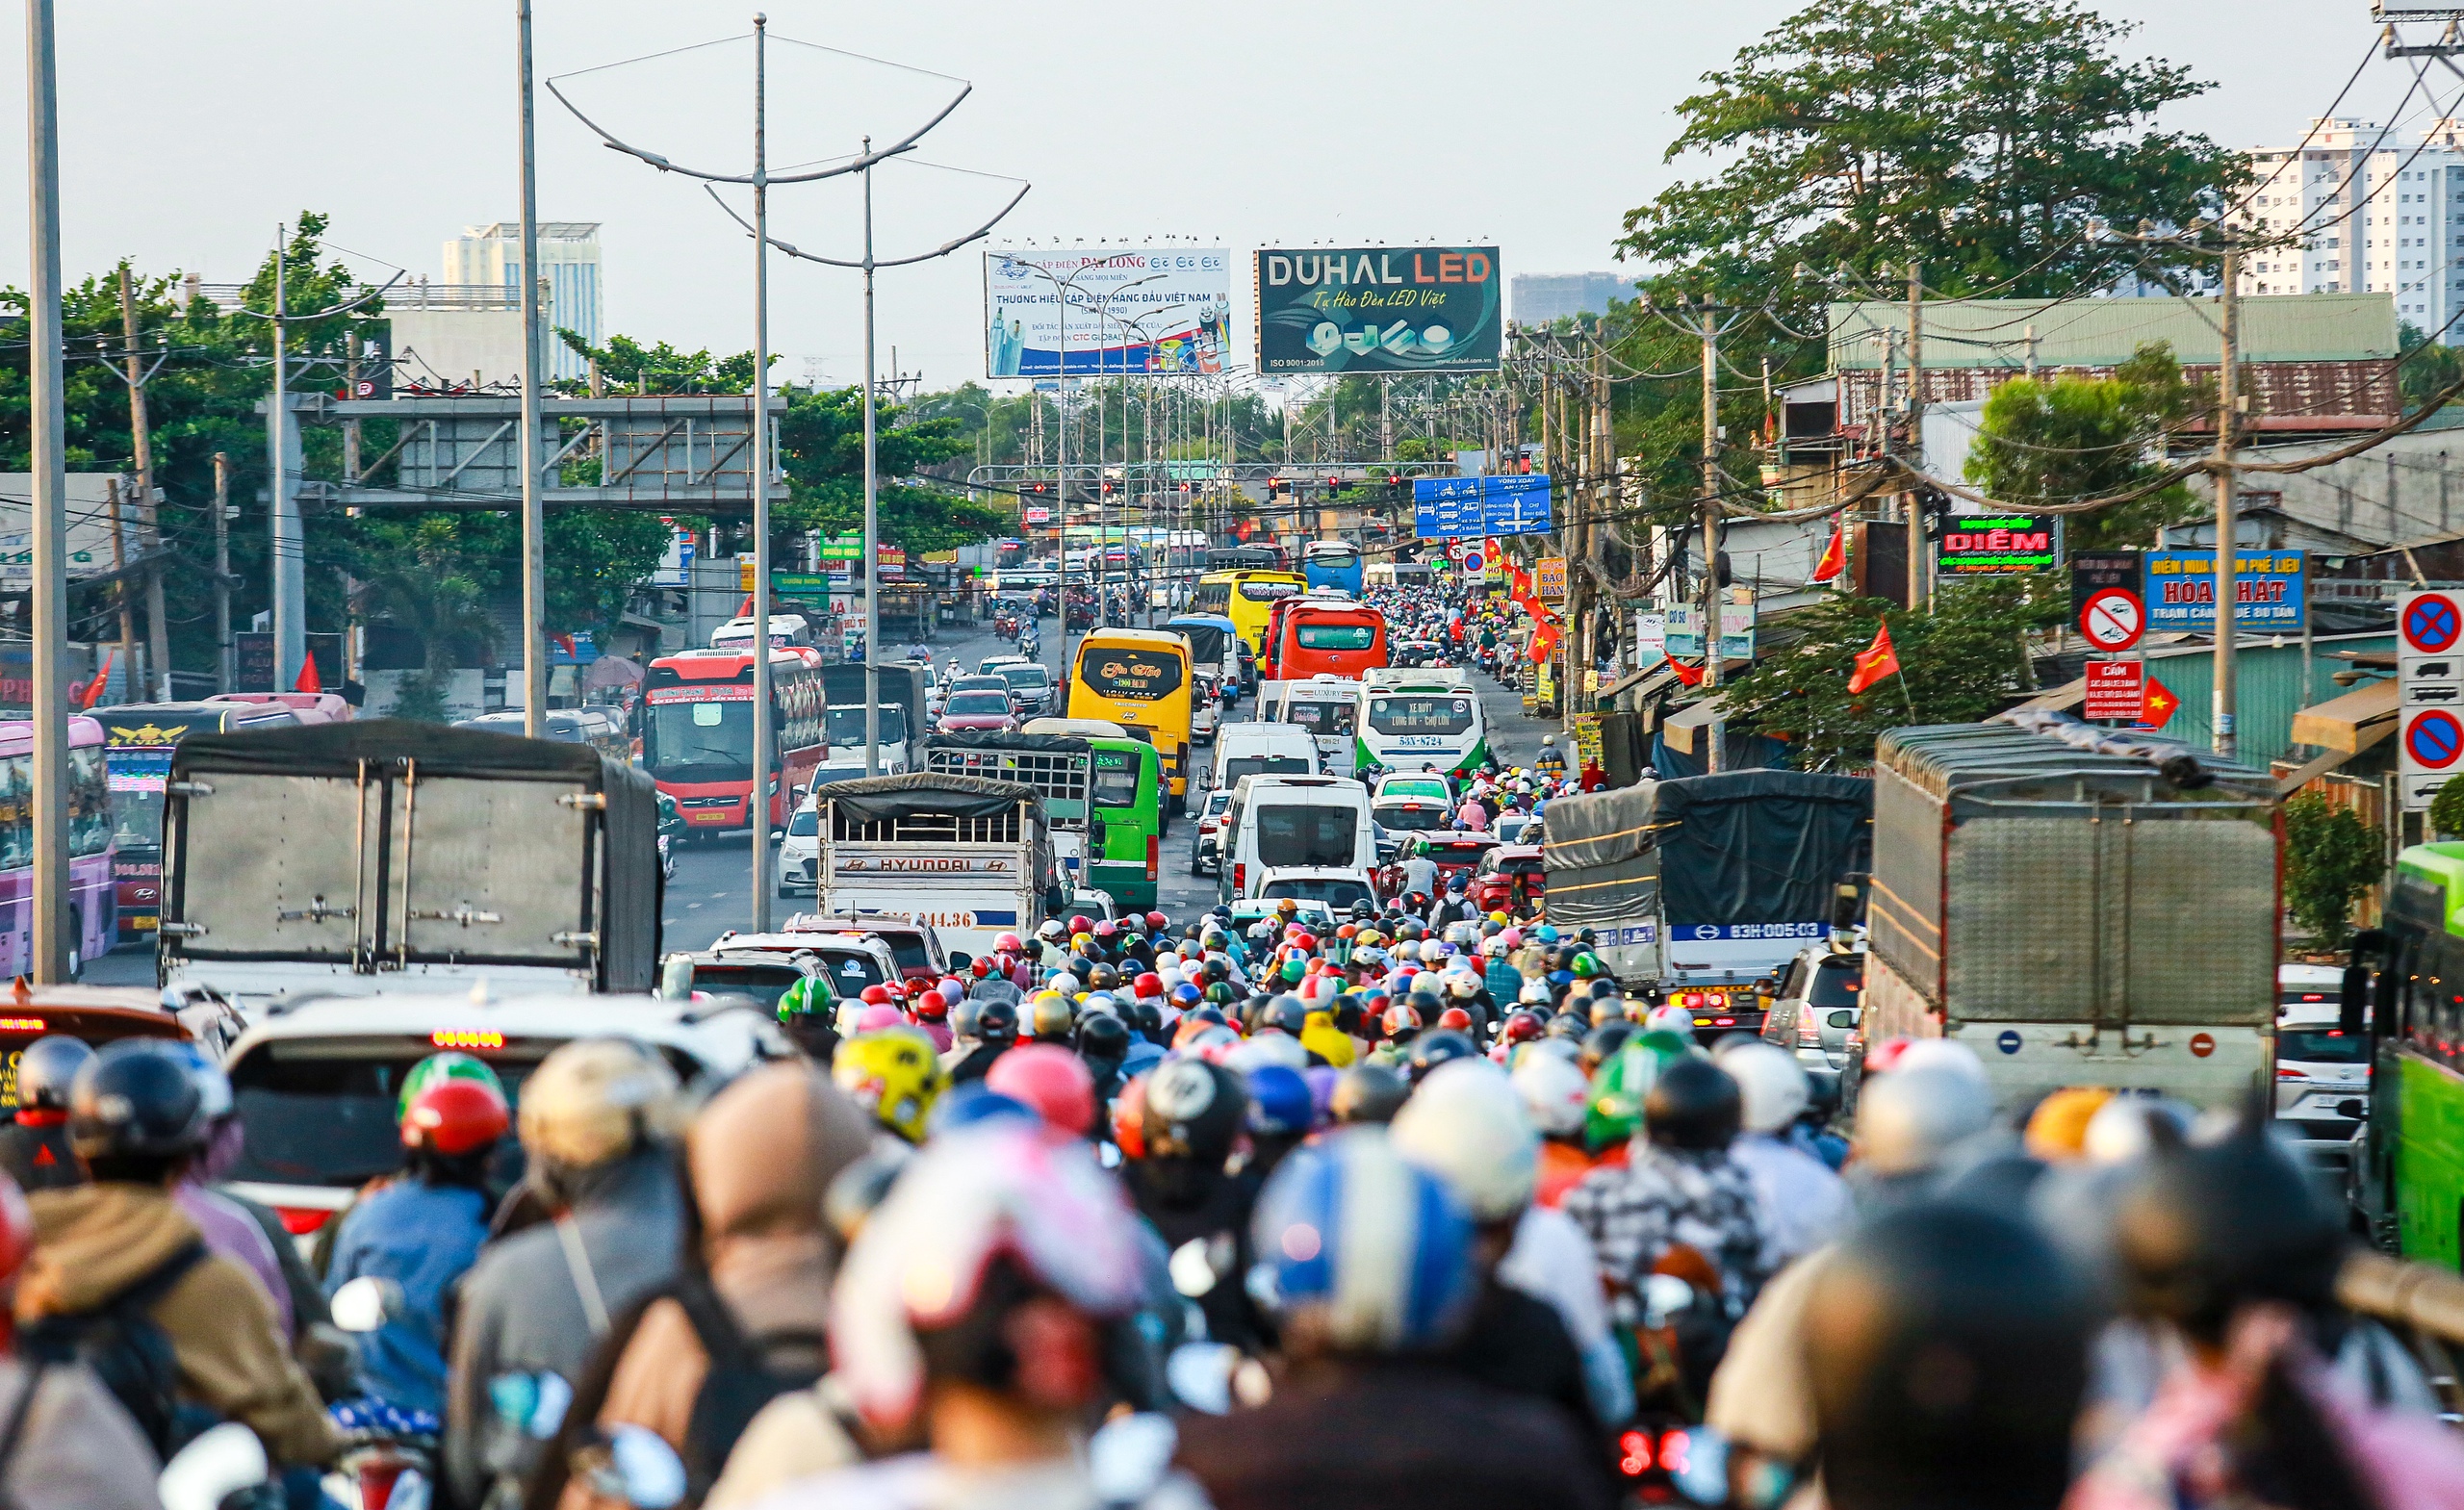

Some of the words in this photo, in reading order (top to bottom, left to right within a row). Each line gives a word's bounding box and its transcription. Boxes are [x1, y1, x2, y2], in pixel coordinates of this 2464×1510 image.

[1056, 258, 1079, 270] ĐIỆN
[1109, 255, 1146, 269] LONG
[1268, 254, 1402, 285] DUHAL
[1414, 252, 1491, 283] LED
[996, 294, 1037, 304] THƯƠNG
[1112, 292, 1140, 302] HÀNG
[1142, 290, 1163, 302] ĐẦU
[1165, 292, 1186, 304] VIỆT
[1189, 294, 1211, 302] NAM
[1313, 291, 1330, 311] Tự
[1333, 291, 1356, 307] Hào
[1360, 290, 1384, 308] Đèn
[1387, 289, 1416, 307] LED
[1421, 289, 1447, 309] Việt
[1286, 358, 1324, 367] 9001:2015
[1944, 528, 2048, 551] DIỄM
[2151, 554, 2182, 575] ĐIỂM
[2184, 560, 2210, 574] MUA
[2249, 554, 2272, 574] PHẾ
[2275, 556, 2300, 576] LIỆU
[2163, 575, 2215, 603] HÒA
[2236, 575, 2288, 603] HÁT
[2152, 608, 2188, 622] TRẠM
[2253, 607, 2271, 618] 80
[2272, 603, 2297, 618] TẤN
[2101, 663, 2127, 677] CẤM
[1409, 703, 1417, 713] XE
[1418, 702, 1433, 713] BUÝT
[1392, 716, 1407, 727] LONG
[881, 859, 972, 871] HYUNDAI
